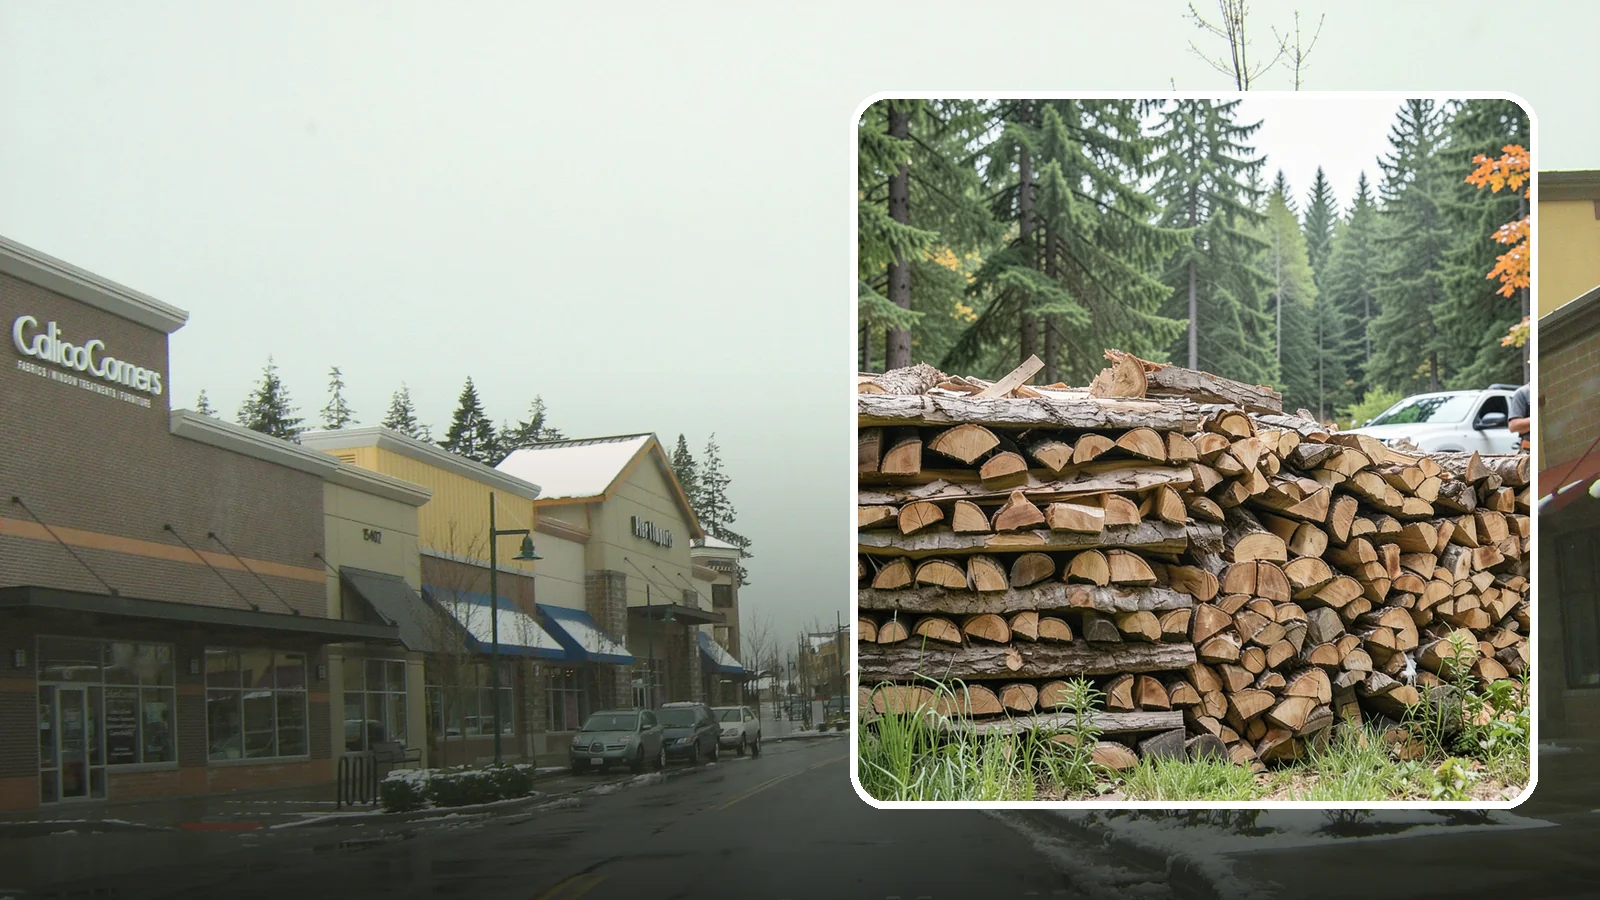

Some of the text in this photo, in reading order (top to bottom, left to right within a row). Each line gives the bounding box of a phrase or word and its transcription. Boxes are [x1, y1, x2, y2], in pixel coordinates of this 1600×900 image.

[17, 360, 47, 378] FABRICS
[52, 370, 78, 387] WINDOW
[79, 378, 116, 399] TREATMENTS
[120, 391, 151, 409] FURNITURE
